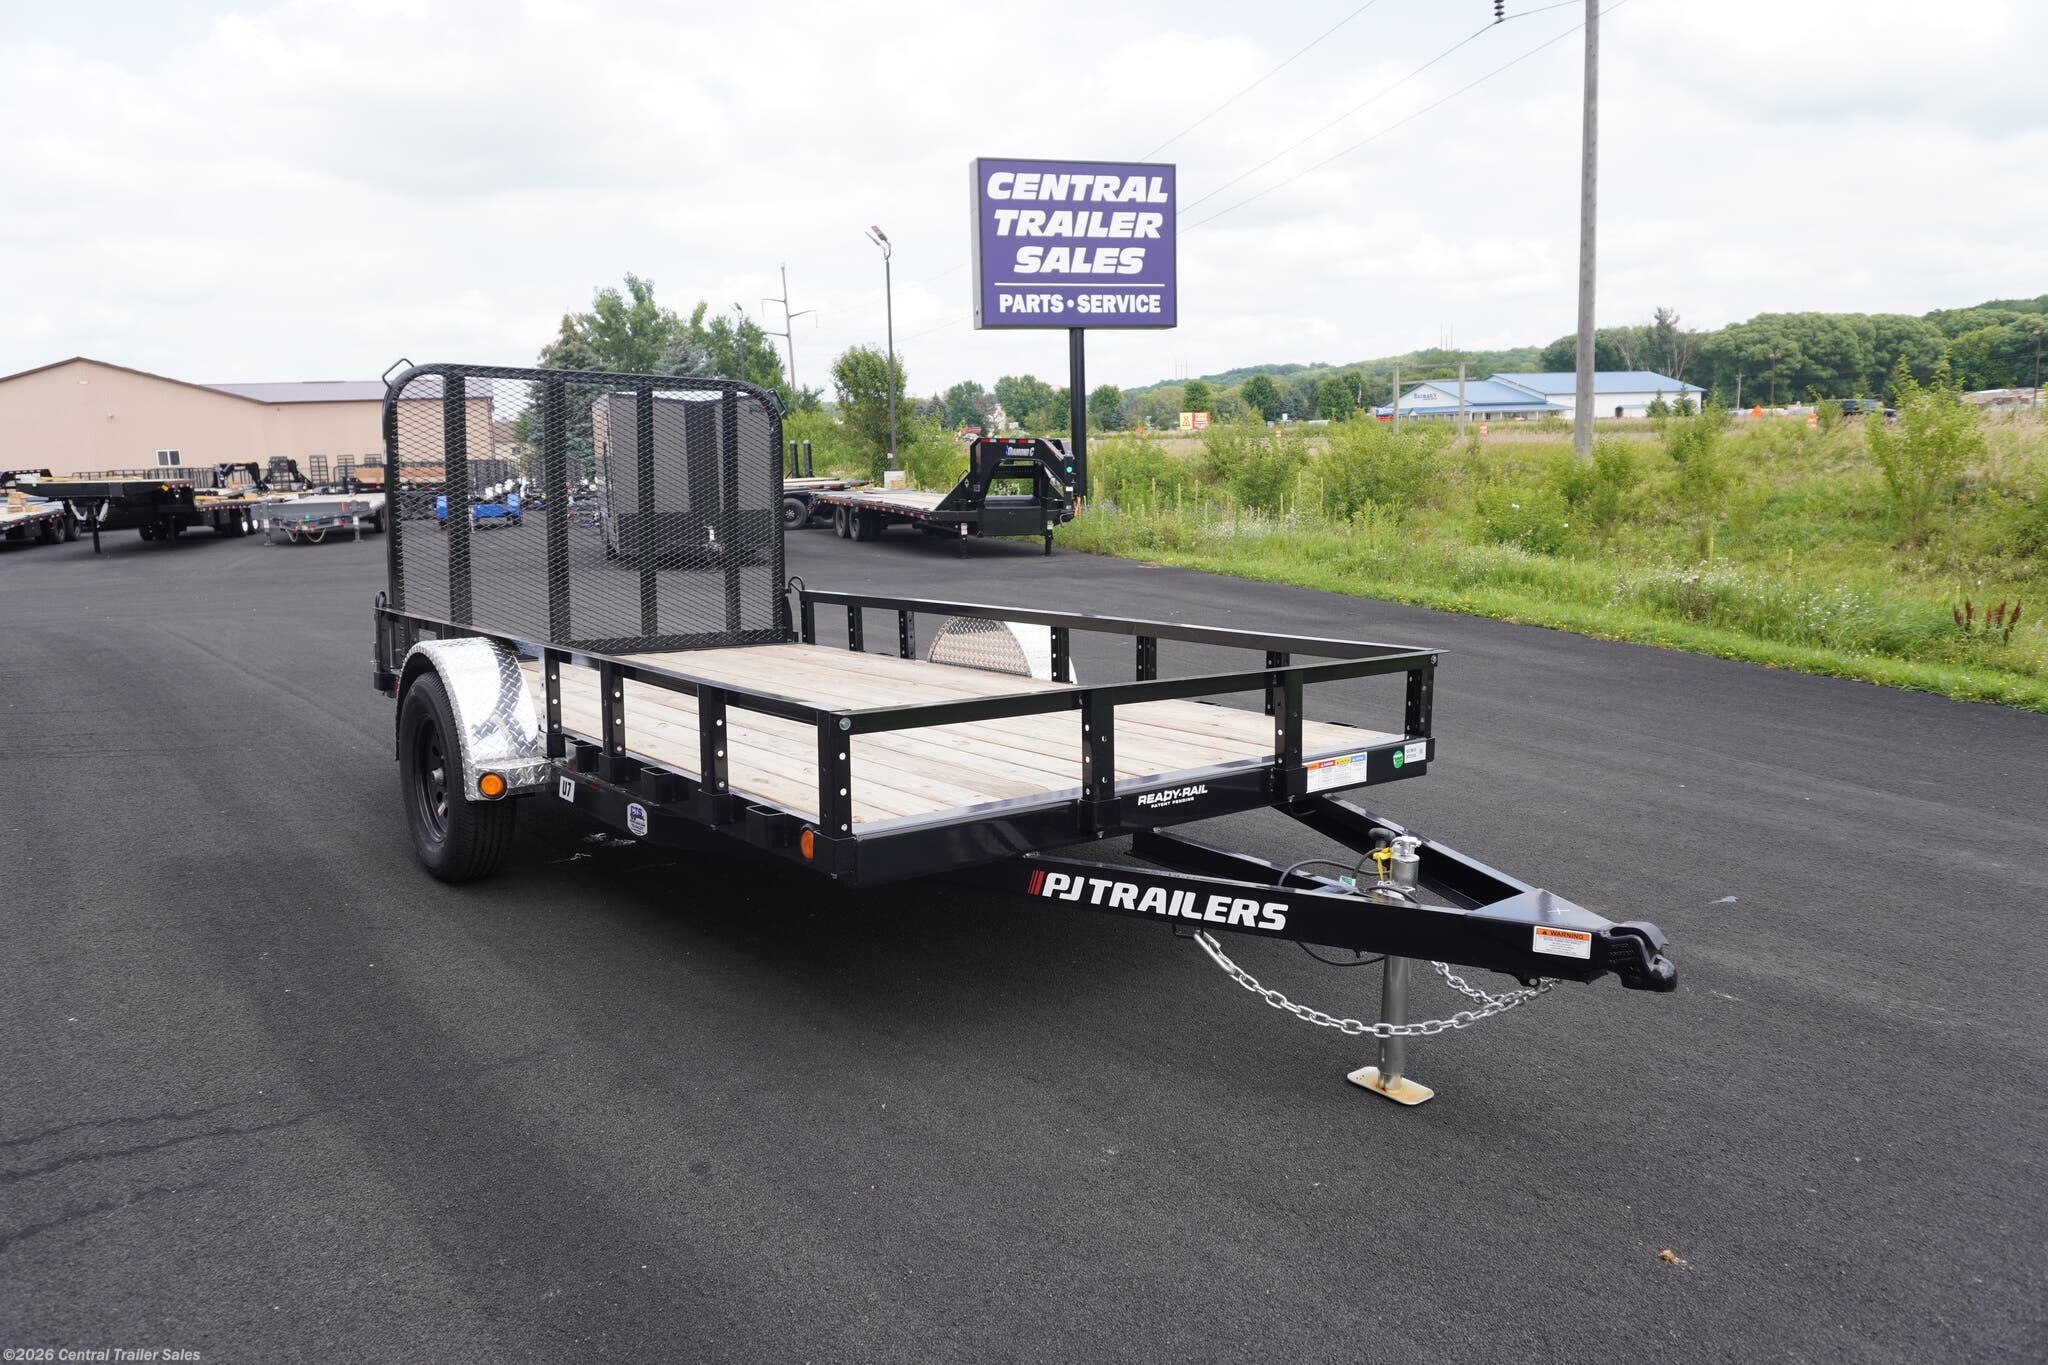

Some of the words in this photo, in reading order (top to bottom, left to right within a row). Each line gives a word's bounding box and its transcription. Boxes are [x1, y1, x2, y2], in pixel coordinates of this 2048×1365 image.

[987, 172, 1168, 203] CENTRAL
[994, 209, 1163, 238] TRAILER
[1013, 246, 1146, 275] SALES
[1000, 294, 1065, 313] PARTS
[1077, 294, 1161, 313] SERVICE
[562, 780, 572, 797] U7
[1042, 872, 1085, 901] PJ
[1089, 878, 1289, 931] TRAILERS
[1550, 930, 1584, 940] WARNING
